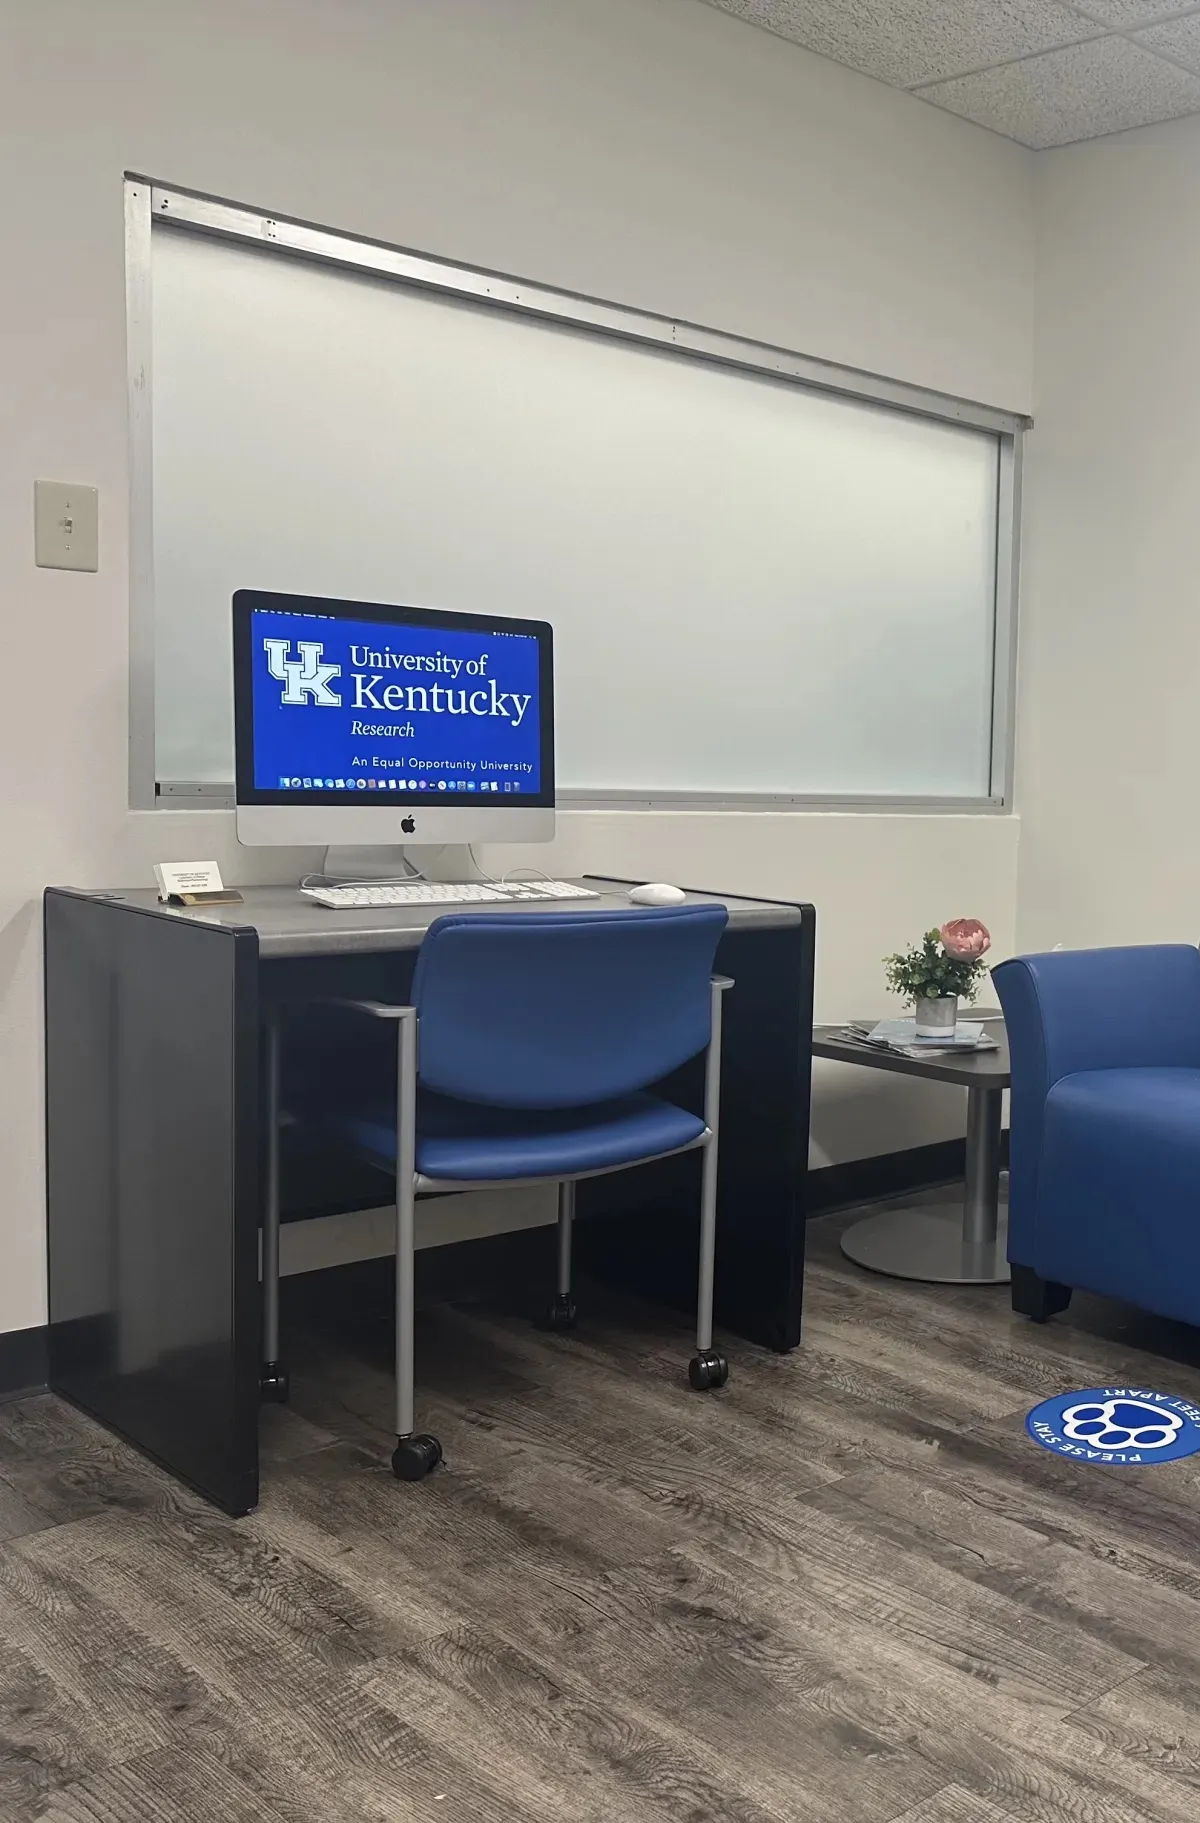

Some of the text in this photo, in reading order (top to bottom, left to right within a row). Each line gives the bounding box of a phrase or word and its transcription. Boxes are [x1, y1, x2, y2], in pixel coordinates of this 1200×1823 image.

[263, 637, 342, 708] UK
[349, 644, 489, 679] University of
[350, 672, 532, 726] Kentucky
[350, 720, 415, 738] Research
[352, 756, 533, 774] An Equal Opportunity University
[1102, 1388, 1169, 1400] APART
[1033, 1420, 1143, 1462] PLEASE STAY
